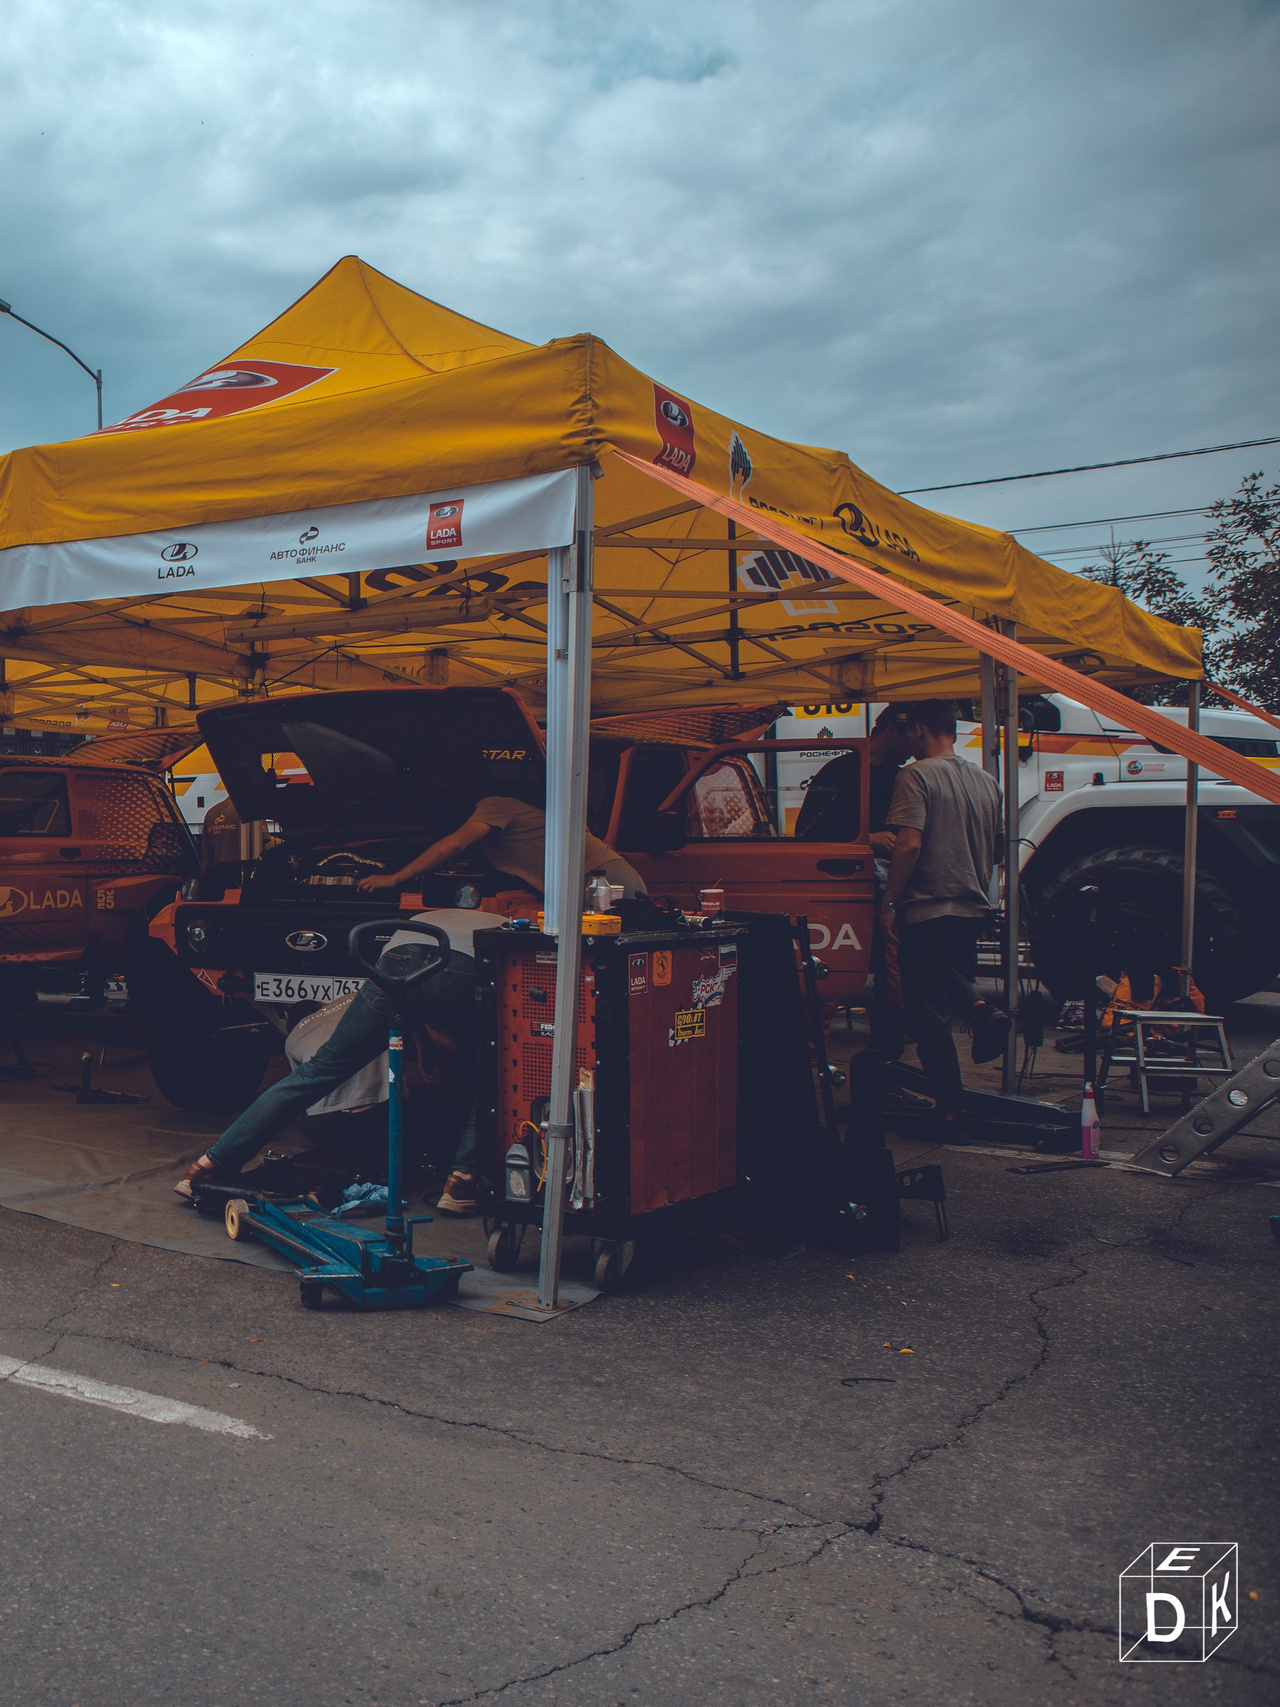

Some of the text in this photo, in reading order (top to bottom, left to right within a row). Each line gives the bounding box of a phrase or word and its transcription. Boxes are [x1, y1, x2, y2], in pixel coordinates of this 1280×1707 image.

[661, 442, 691, 473] LADA
[430, 527, 457, 540] LADA
[430, 537, 458, 547] SPORT
[876, 524, 920, 562] LADA
[296, 556, 317, 565] БАНК
[157, 565, 196, 580] LADA
[800, 750, 849, 758] РОСНЕФТ
[29, 889, 83, 910] LADA
[335, 980, 359, 996] 763
[630, 976, 646, 987] LADA
